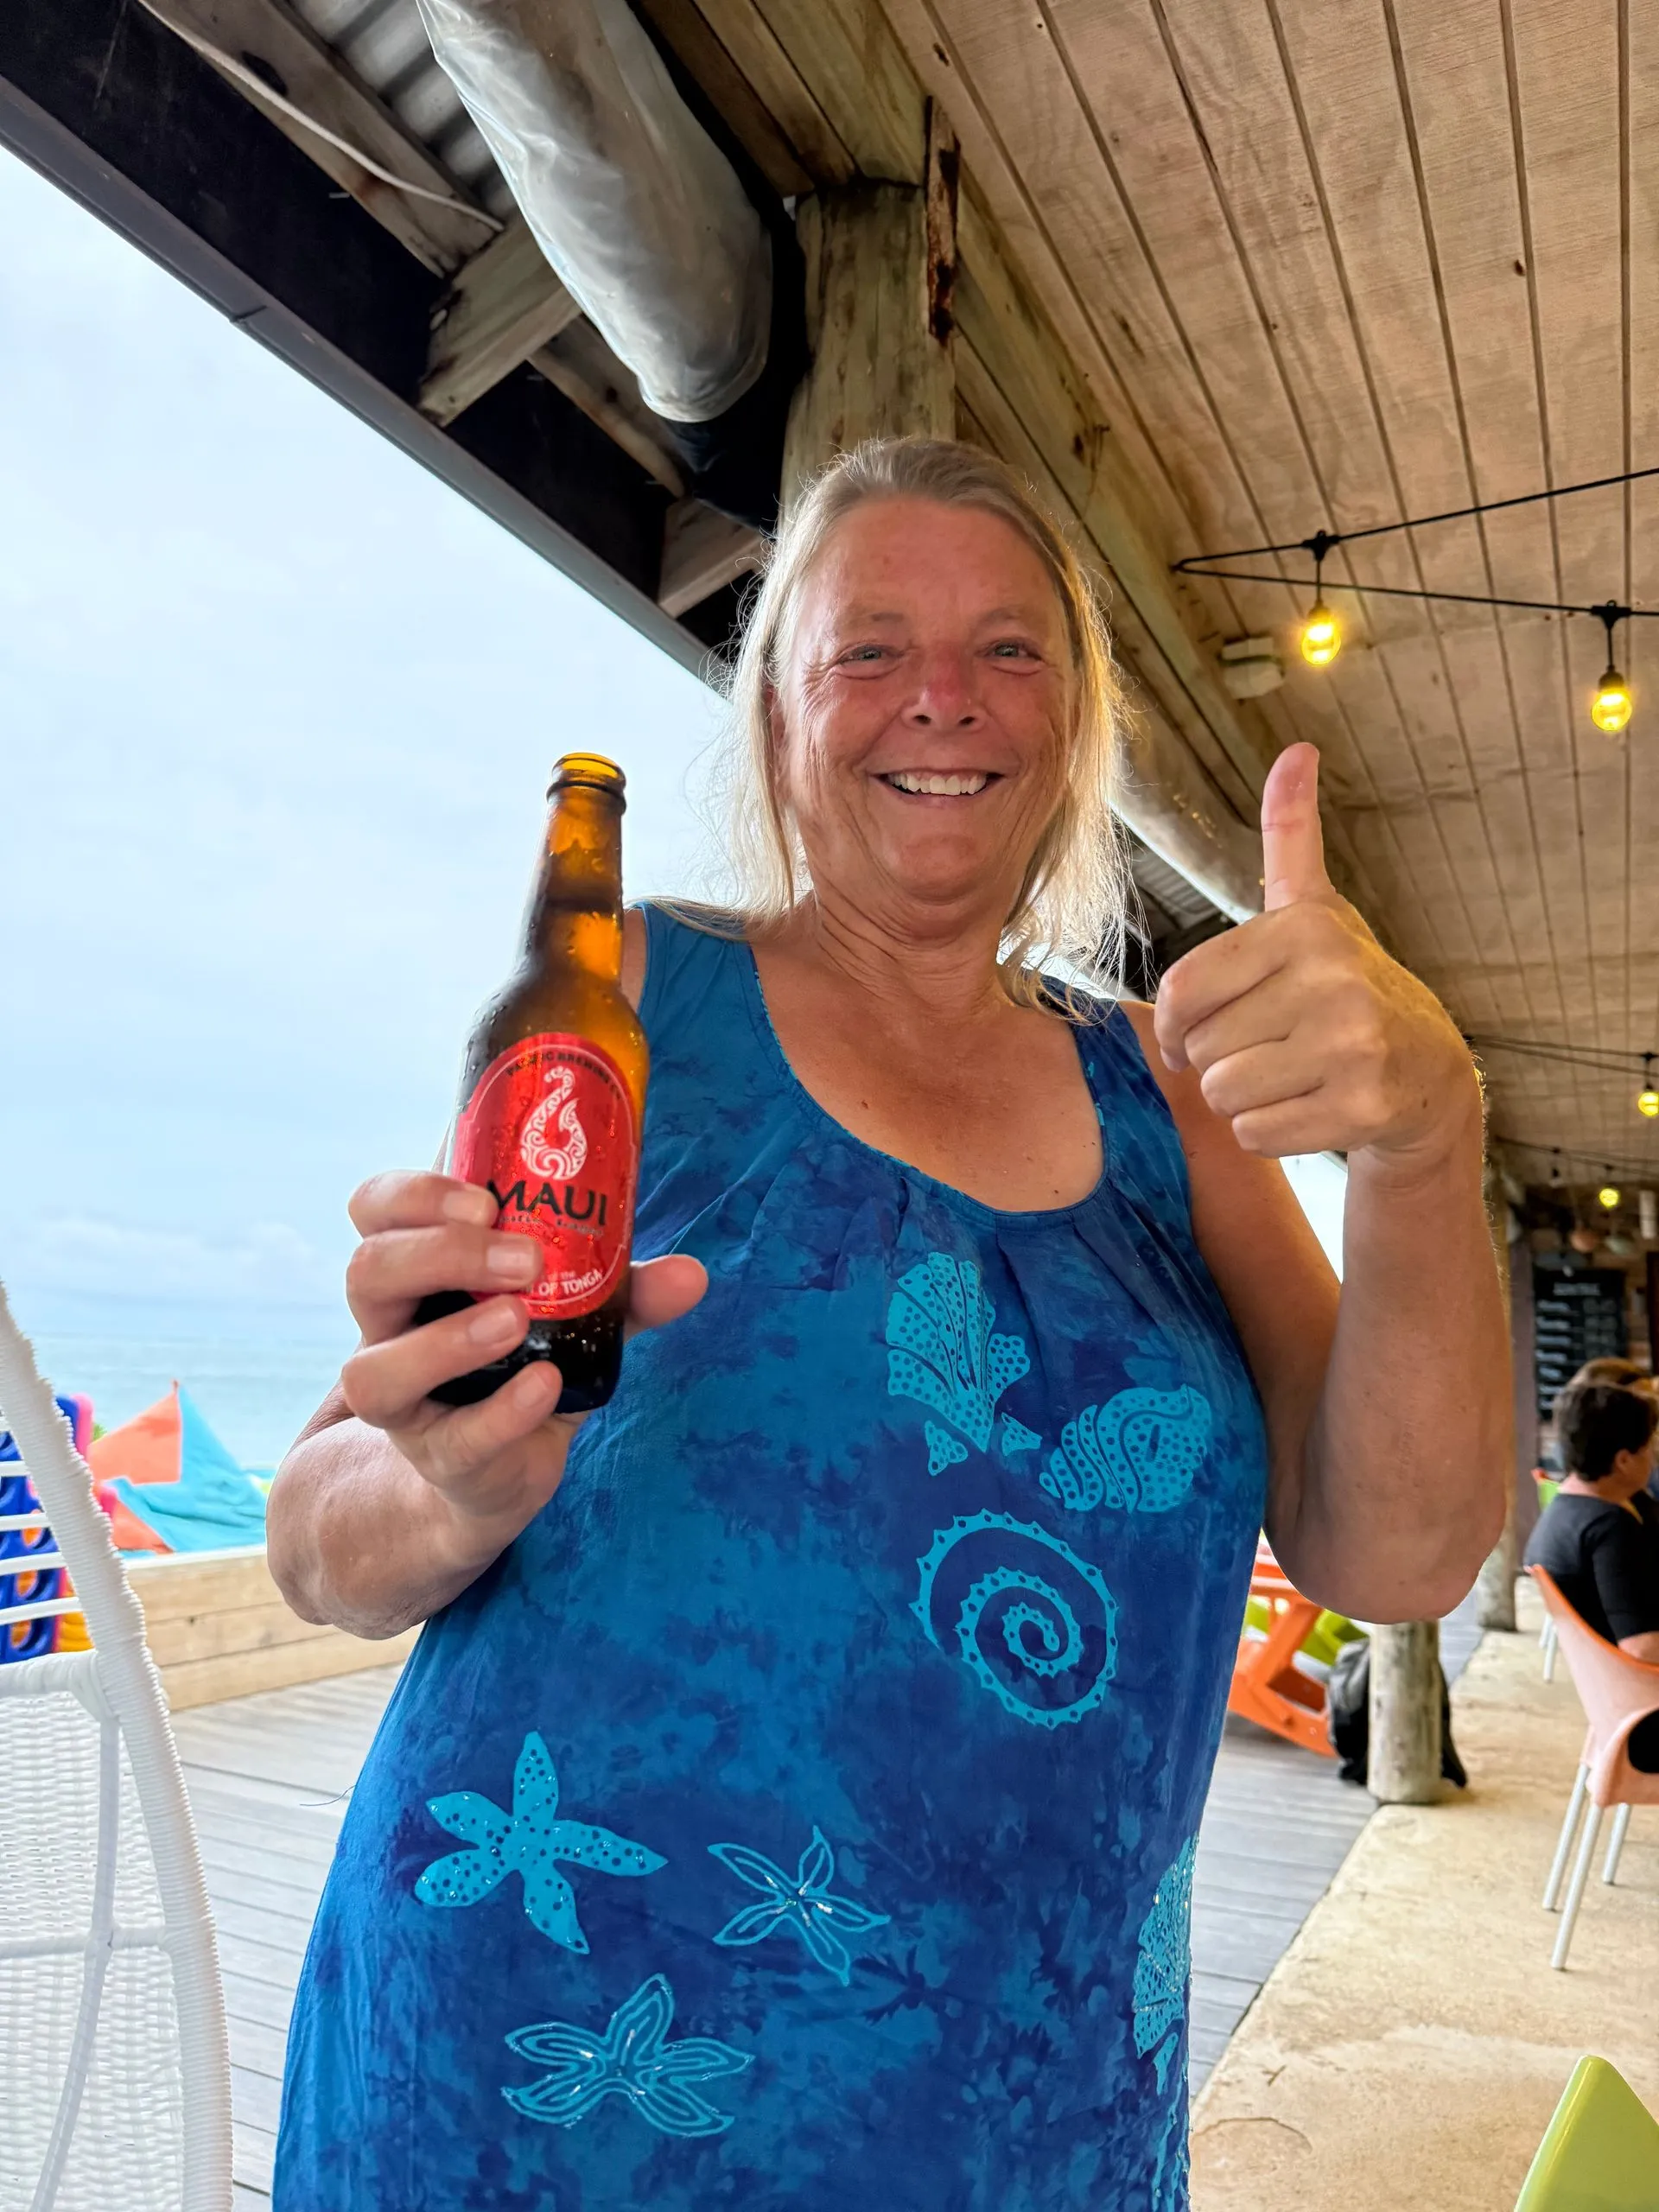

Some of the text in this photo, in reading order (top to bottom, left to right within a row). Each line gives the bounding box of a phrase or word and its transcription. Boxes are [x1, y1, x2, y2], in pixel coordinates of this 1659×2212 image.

[486, 1179, 607, 1226] MAUI
[538, 1281, 557, 1295] OF
[562, 1268, 604, 1295] TONGA
